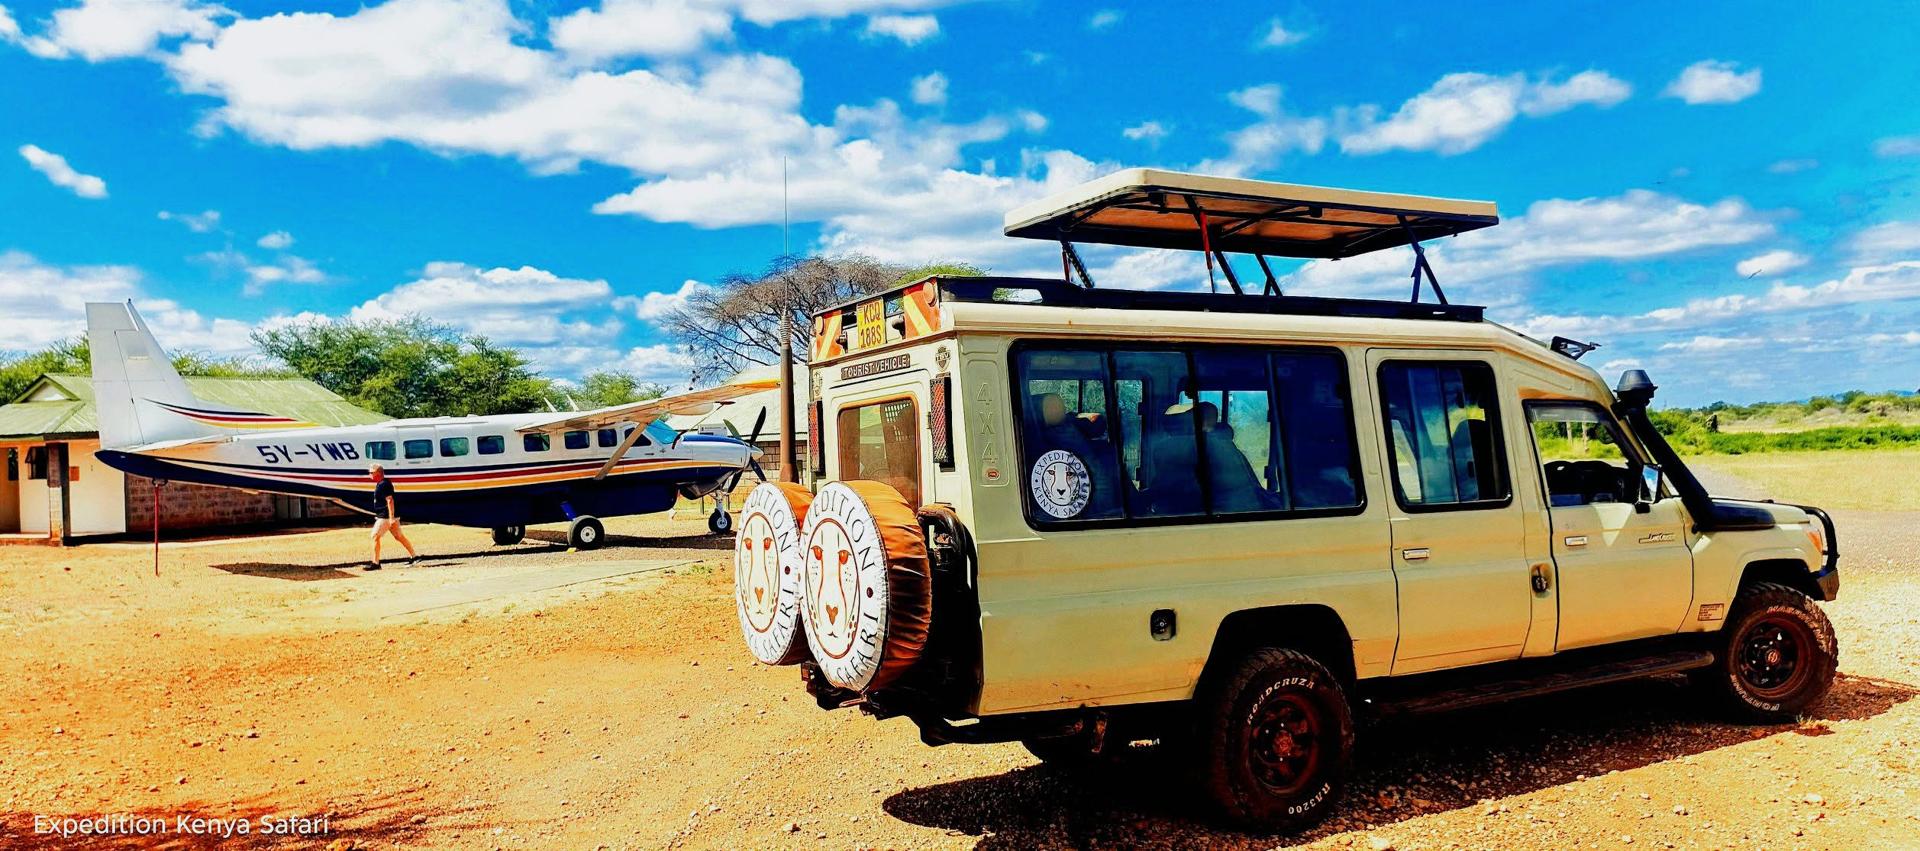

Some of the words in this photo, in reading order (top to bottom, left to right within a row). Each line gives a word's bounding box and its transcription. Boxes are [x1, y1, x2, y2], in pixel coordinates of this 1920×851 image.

[863, 302, 881, 324] KCQ
[859, 325, 882, 348] 188S
[844, 363, 873, 377] TOURIST
[256, 442, 360, 464] 5Y-YWB
[1034, 452, 1087, 479] EXPEDITION
[1034, 486, 1059, 515] KENYA
[836, 612, 879, 687] SAFARI
[1247, 677, 1315, 725] ROADCRUZA
